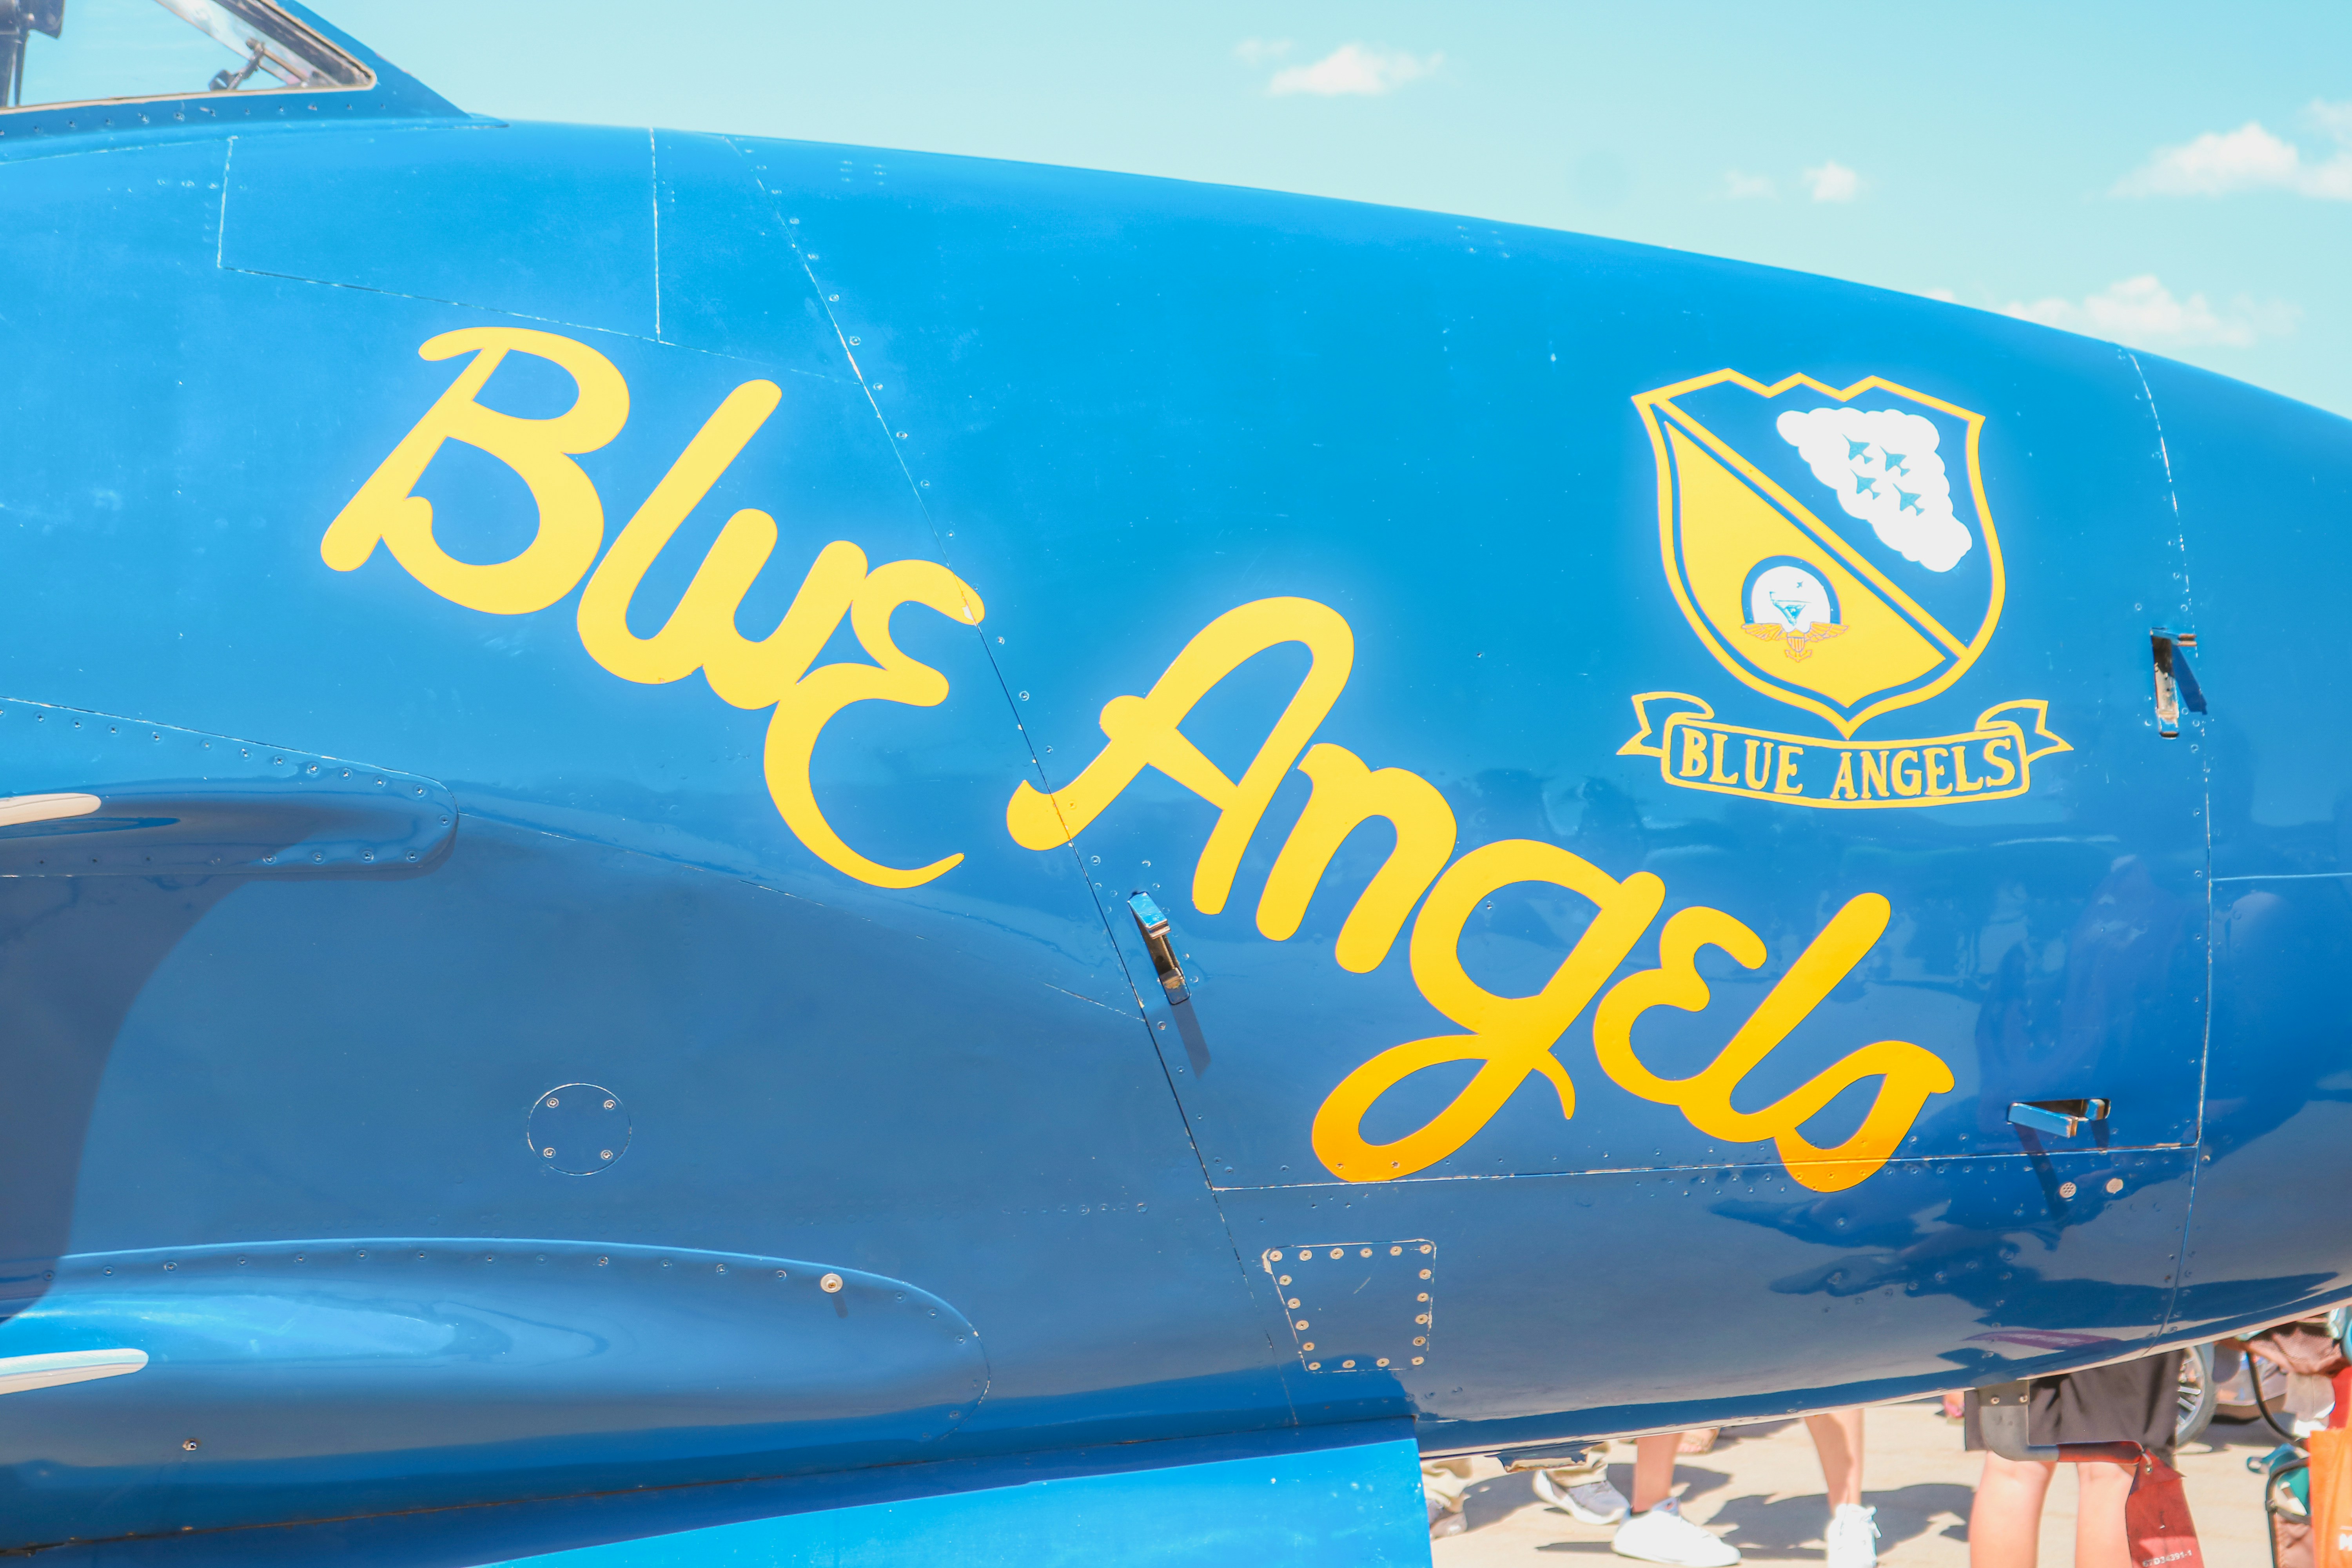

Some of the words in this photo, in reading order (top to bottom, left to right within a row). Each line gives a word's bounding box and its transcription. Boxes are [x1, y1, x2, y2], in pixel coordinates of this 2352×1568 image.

[1006, 597, 1955, 1193] Angels
[1679, 727, 1804, 795] BLUE
[1829, 738, 2016, 800] ANGELS
